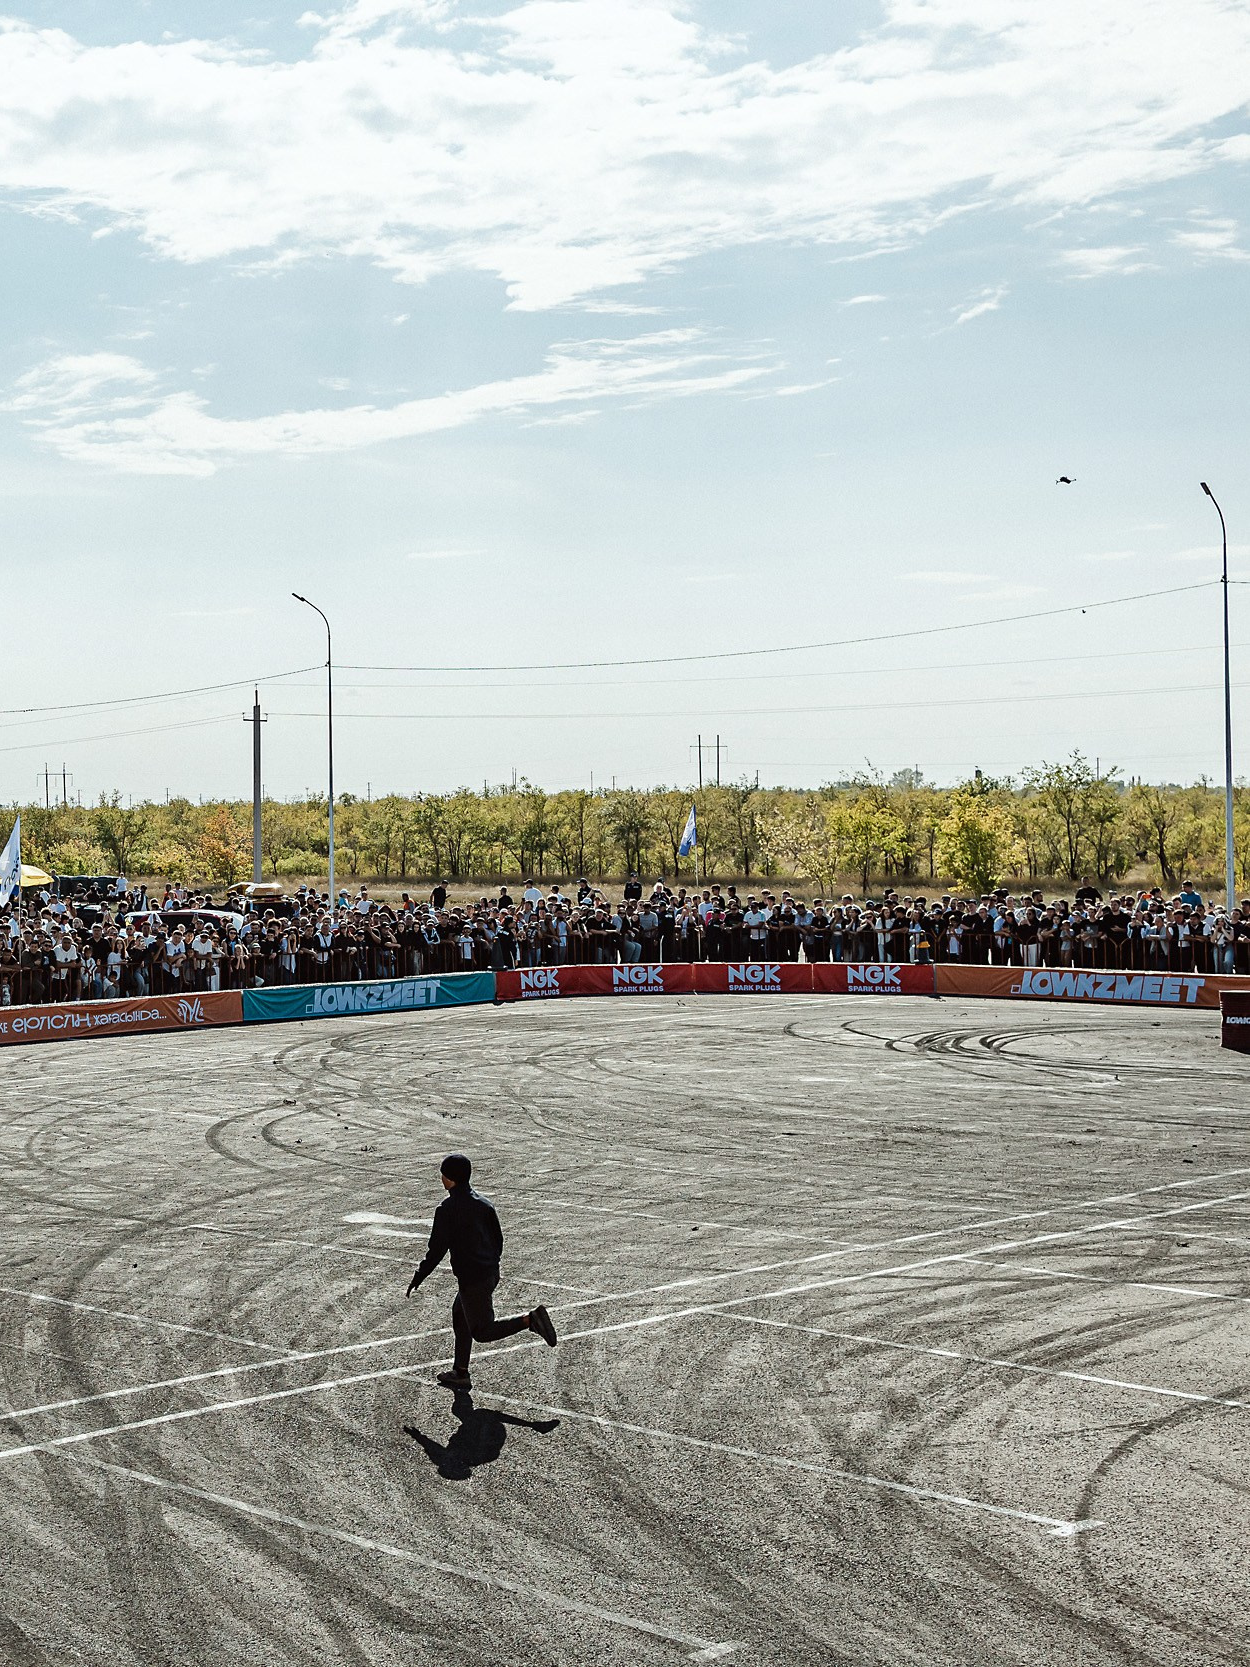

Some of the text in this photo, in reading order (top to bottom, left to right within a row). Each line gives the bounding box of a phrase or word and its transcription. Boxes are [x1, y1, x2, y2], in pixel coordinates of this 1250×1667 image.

[521, 968, 559, 989] NGK
[612, 965, 664, 985] NGK
[728, 965, 781, 984] NGK
[847, 965, 901, 985] NGK
[313, 979, 440, 1013] LOWKZMEET
[613, 985, 637, 993] SPARK
[848, 985, 875, 993] SPARK
[1021, 970, 1205, 1003] LOWKZMEET
